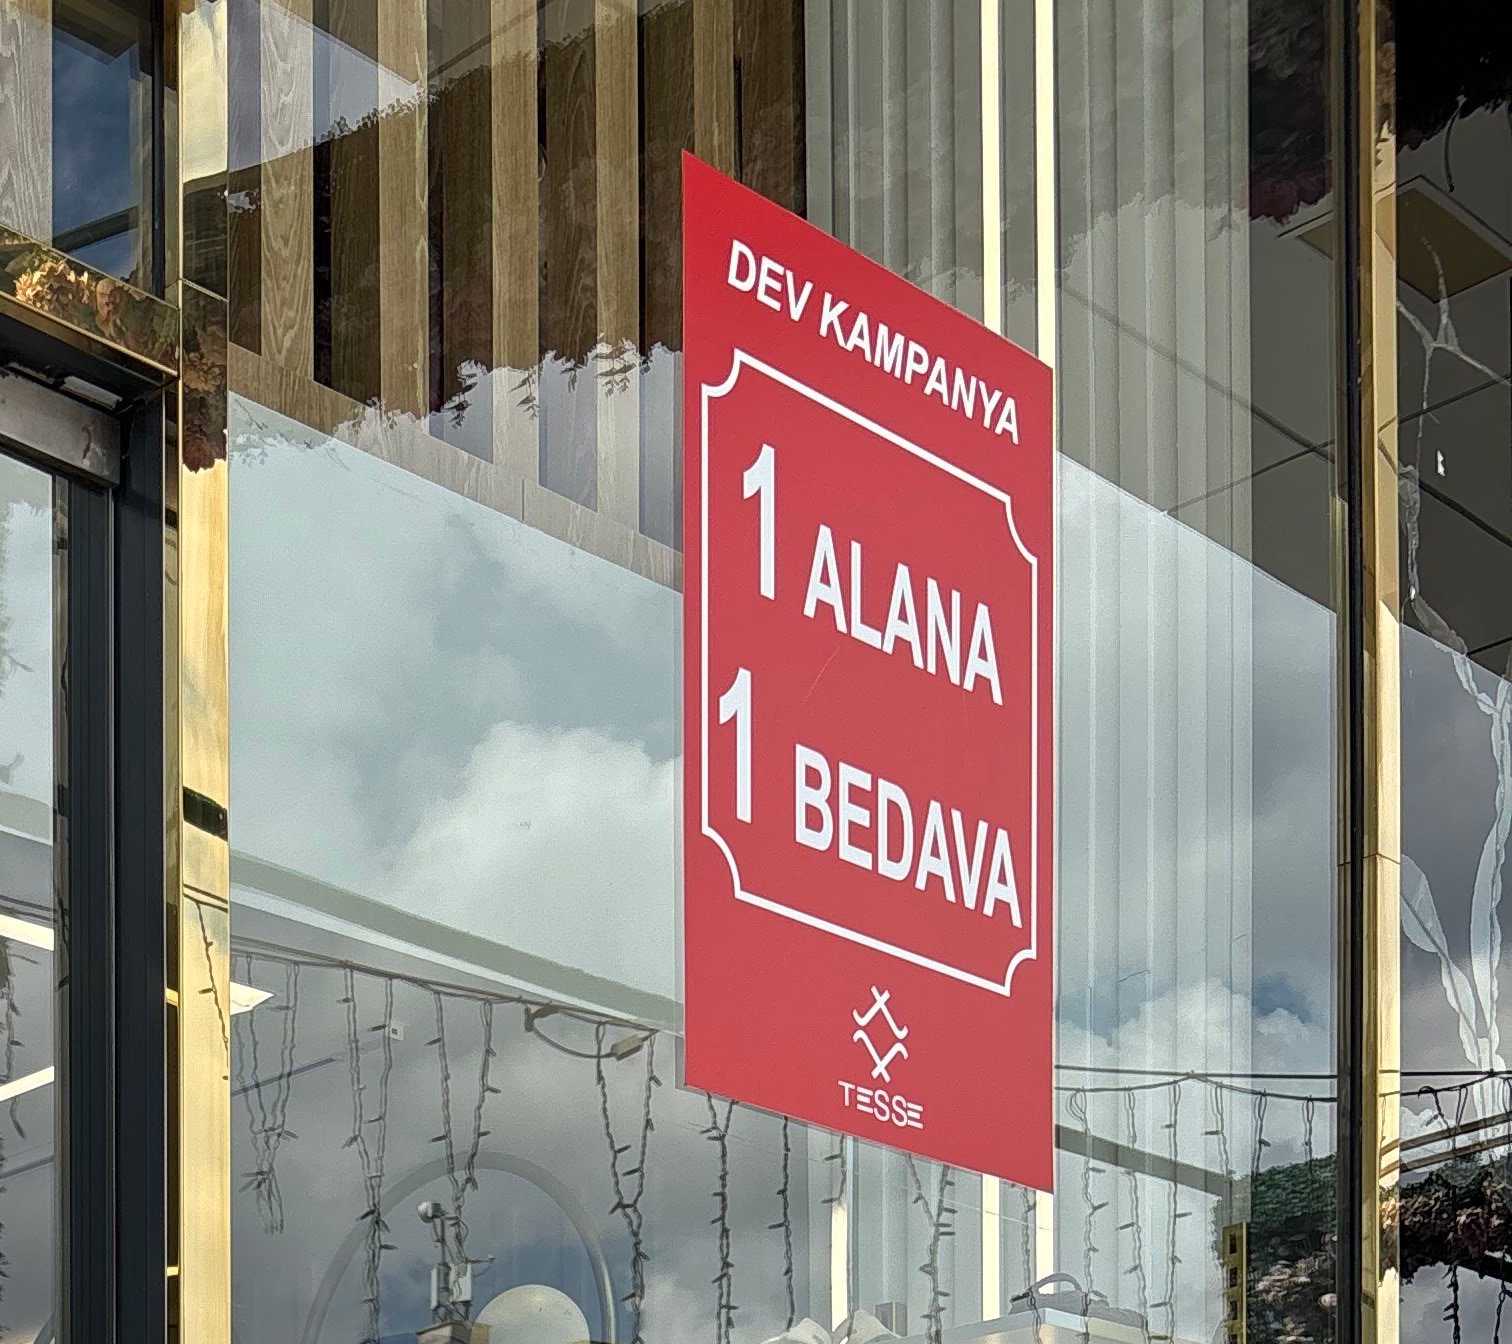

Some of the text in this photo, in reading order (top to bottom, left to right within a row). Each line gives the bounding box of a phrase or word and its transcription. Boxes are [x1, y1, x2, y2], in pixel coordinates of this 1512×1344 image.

[727, 239, 1020, 446] DEV KAMPANYA
[742, 443, 1004, 707] 1 ALANA
[717, 665, 1024, 930] 1 BEDAVA
[837, 1080, 924, 1130] TESSE
